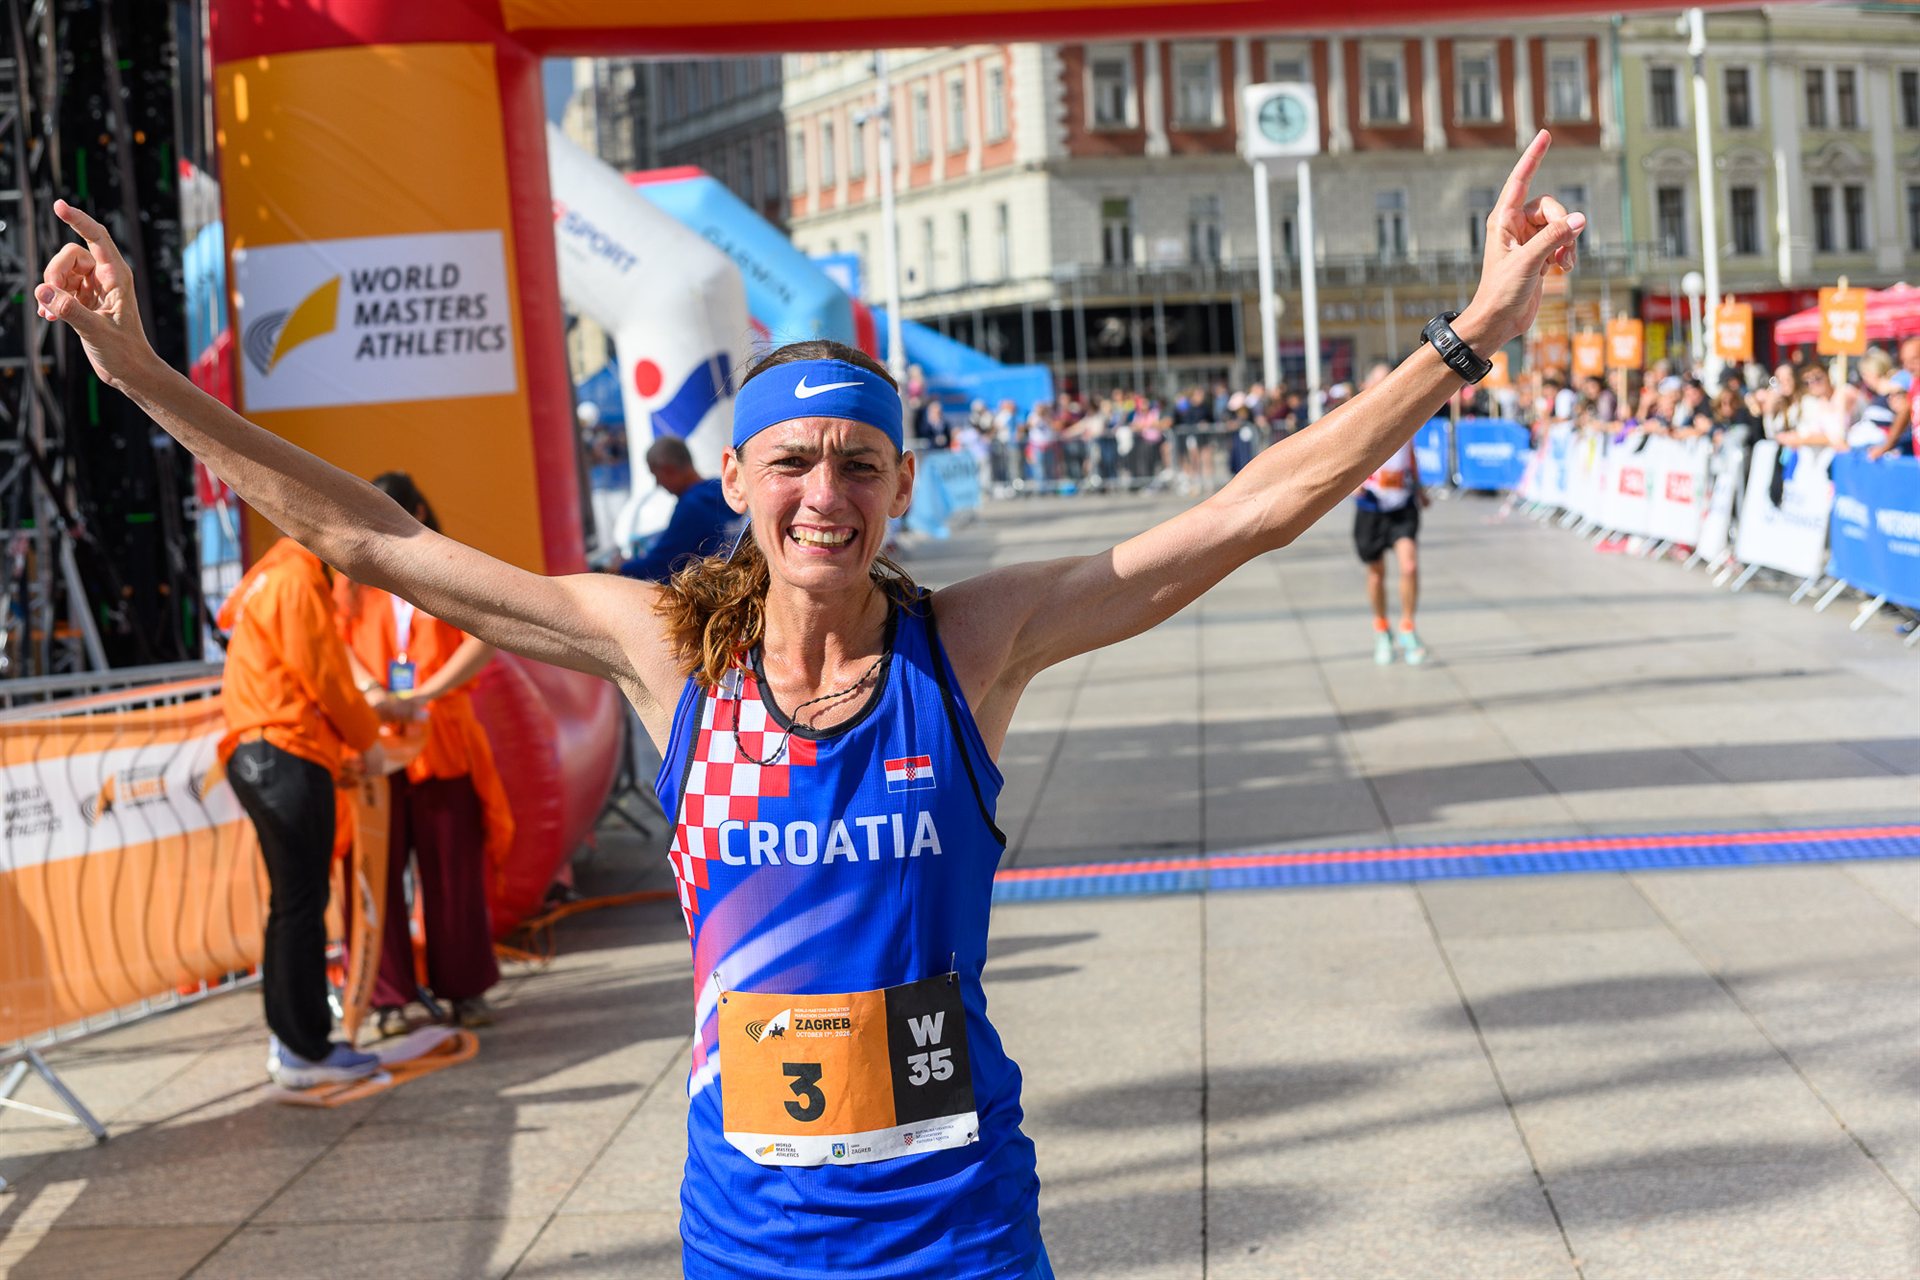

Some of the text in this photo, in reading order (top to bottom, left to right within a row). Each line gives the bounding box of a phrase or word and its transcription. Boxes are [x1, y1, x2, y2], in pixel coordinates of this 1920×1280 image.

[351, 263, 460, 293] WORLD
[354, 294, 487, 326] MASTERS
[355, 325, 506, 360] ATHLETICS
[718, 811, 942, 866] CROATIA
[795, 1018, 851, 1030] ZAGREB
[907, 1011, 945, 1047] W
[907, 1047, 954, 1086] 35
[782, 1062, 826, 1122] 3
